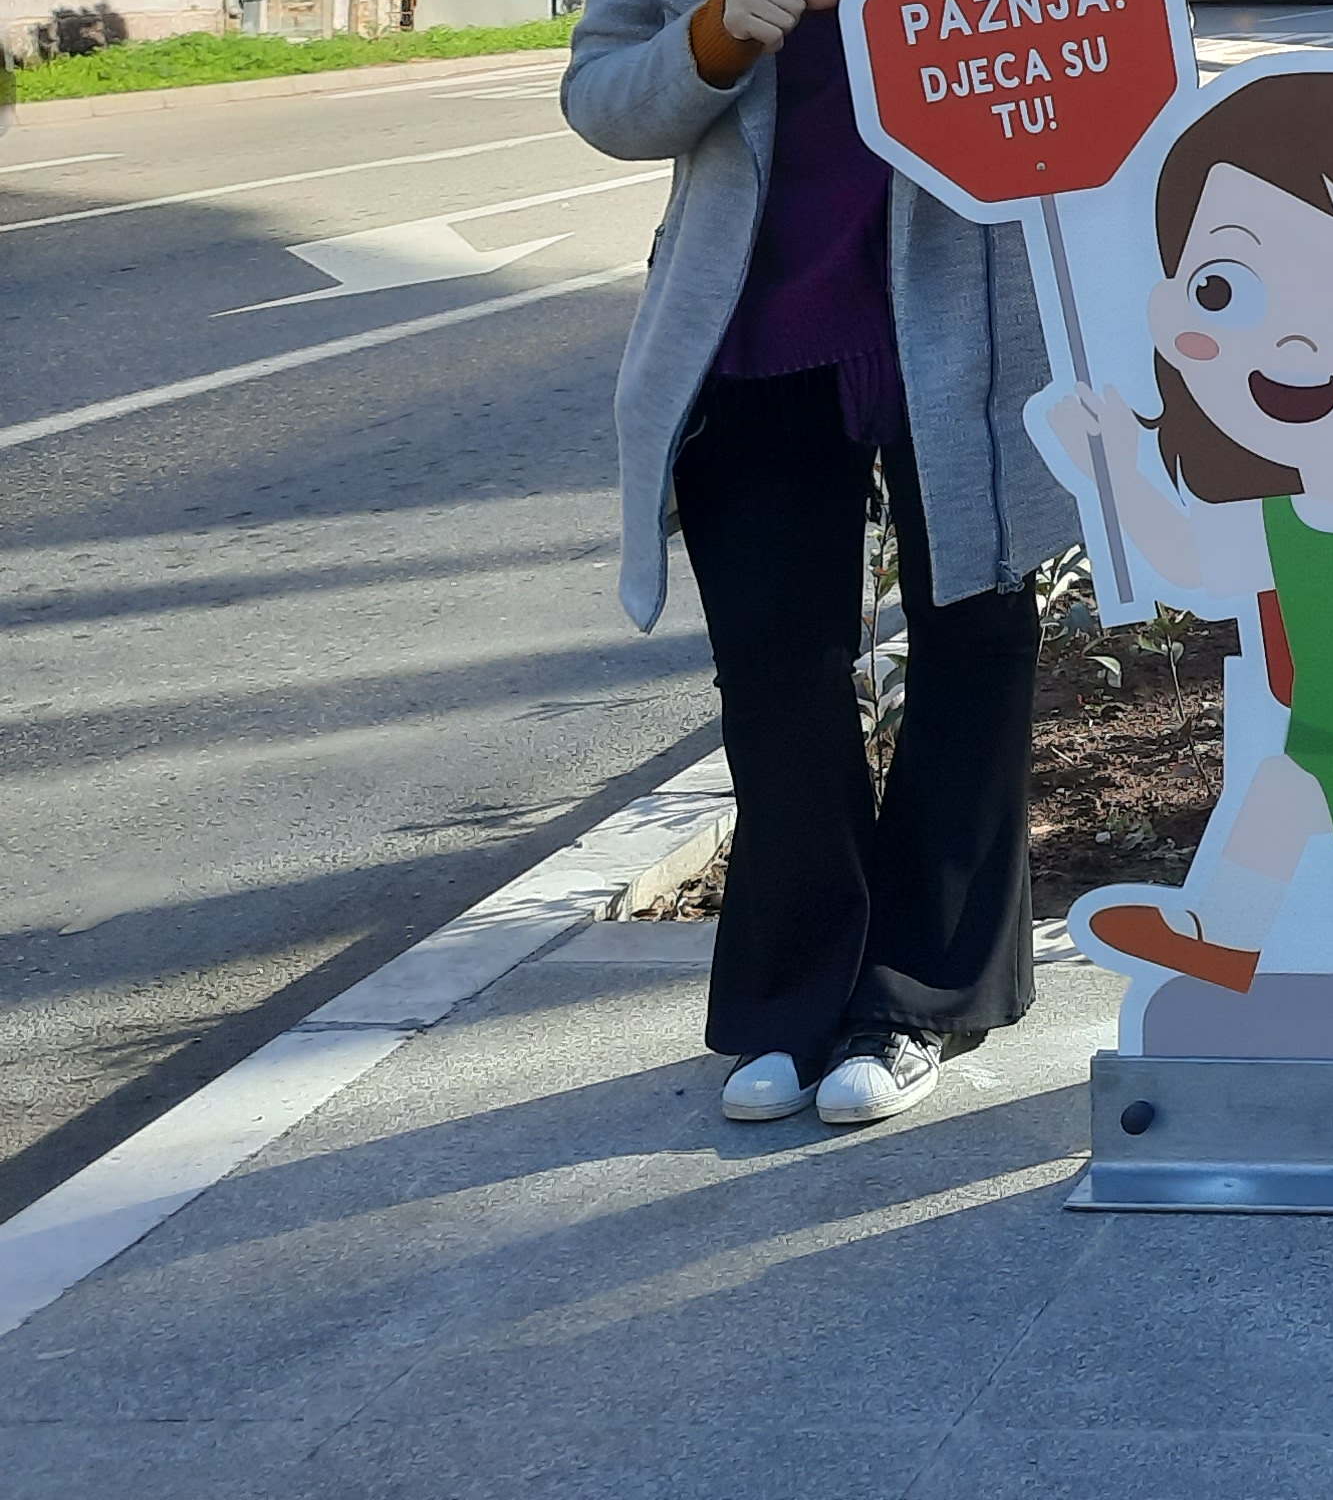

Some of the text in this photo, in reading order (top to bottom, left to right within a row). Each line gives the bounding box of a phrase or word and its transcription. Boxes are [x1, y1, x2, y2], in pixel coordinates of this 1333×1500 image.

[920, 35, 1109, 103] DJECA SU
[991, 95, 1058, 139] TU!
